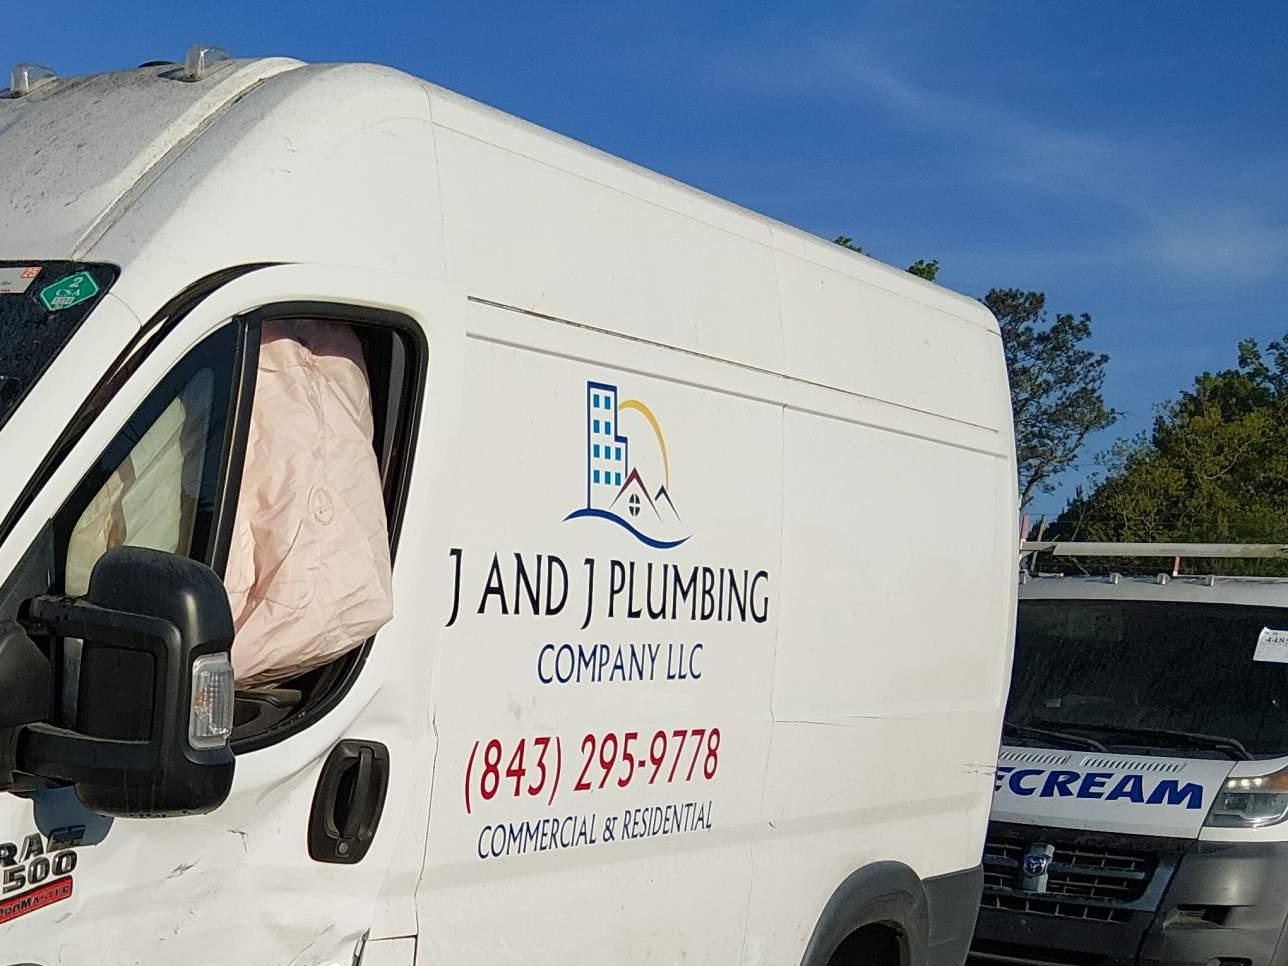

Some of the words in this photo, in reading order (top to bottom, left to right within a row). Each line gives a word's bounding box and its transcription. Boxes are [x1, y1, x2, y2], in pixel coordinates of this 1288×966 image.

[68, 276, 84, 288] 2
[445, 547, 463, 628] J
[477, 551, 569, 616] AND
[580, 558, 595, 630] J
[607, 559, 770, 624] PLUMBING
[537, 643, 661, 684] COMPANY
[666, 643, 704, 681] LLC
[464, 736, 562, 814] (843)
[573, 727, 721, 792] 295-9778
[477, 813, 597, 860] COMMERCIAL
[602, 816, 619, 843] &
[621, 800, 713, 841] RESIDENTIAL
